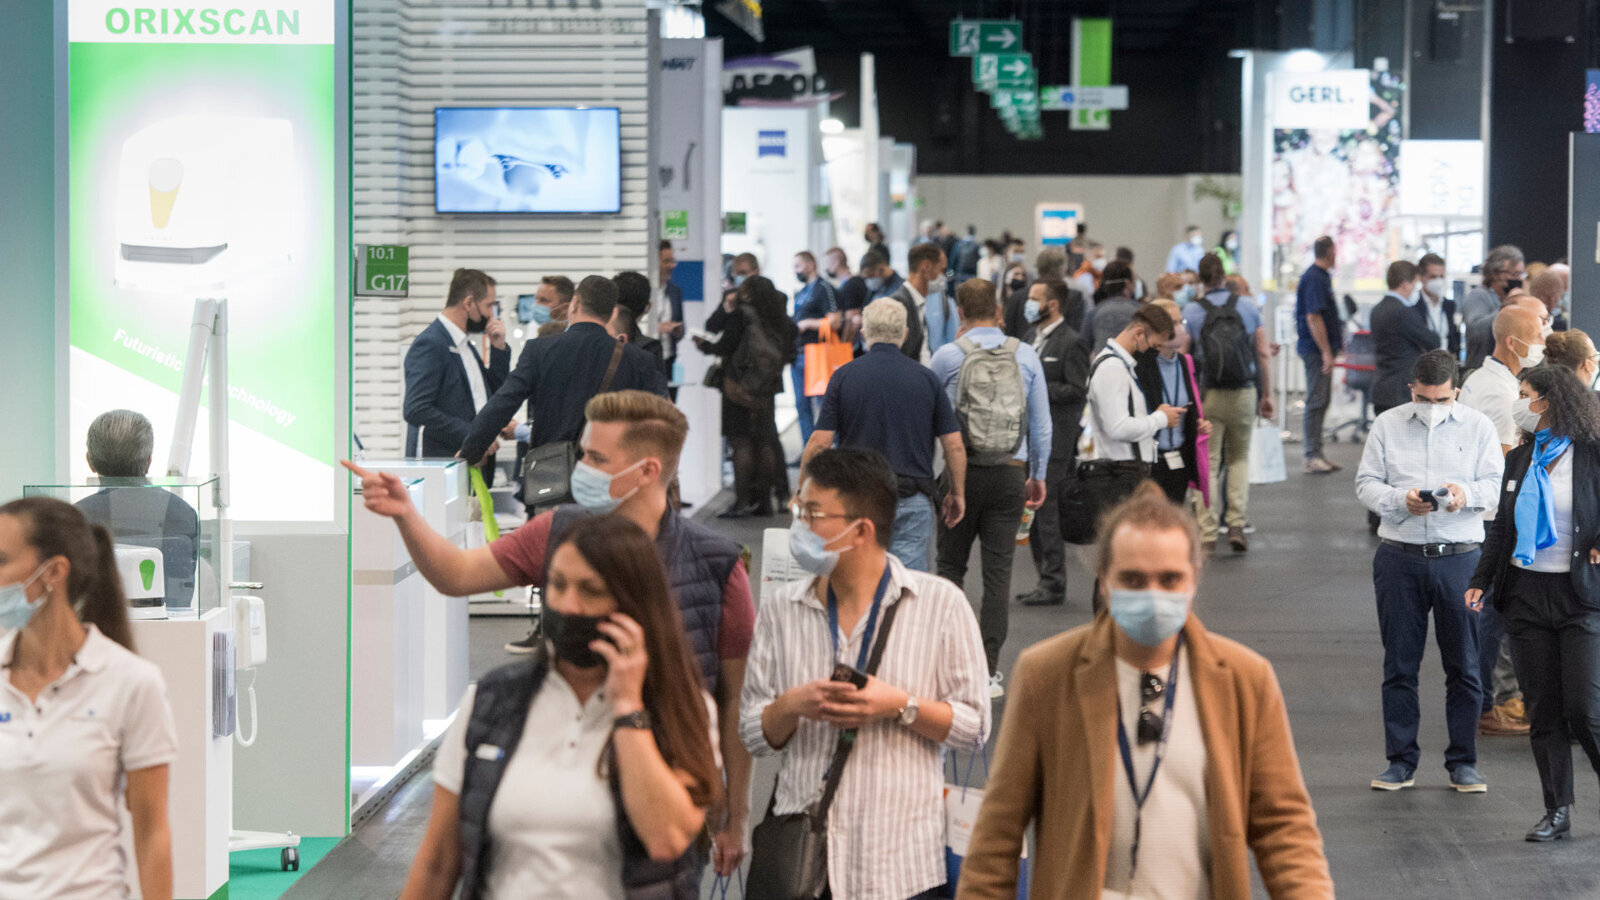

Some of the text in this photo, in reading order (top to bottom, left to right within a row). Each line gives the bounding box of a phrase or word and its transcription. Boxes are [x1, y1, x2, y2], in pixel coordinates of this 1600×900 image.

[105, 7, 300, 35] ORIXSCAN
[369, 246, 394, 260] 10.1
[371, 274, 407, 291] G17
[113, 327, 297, 427] Futuristic chnology
